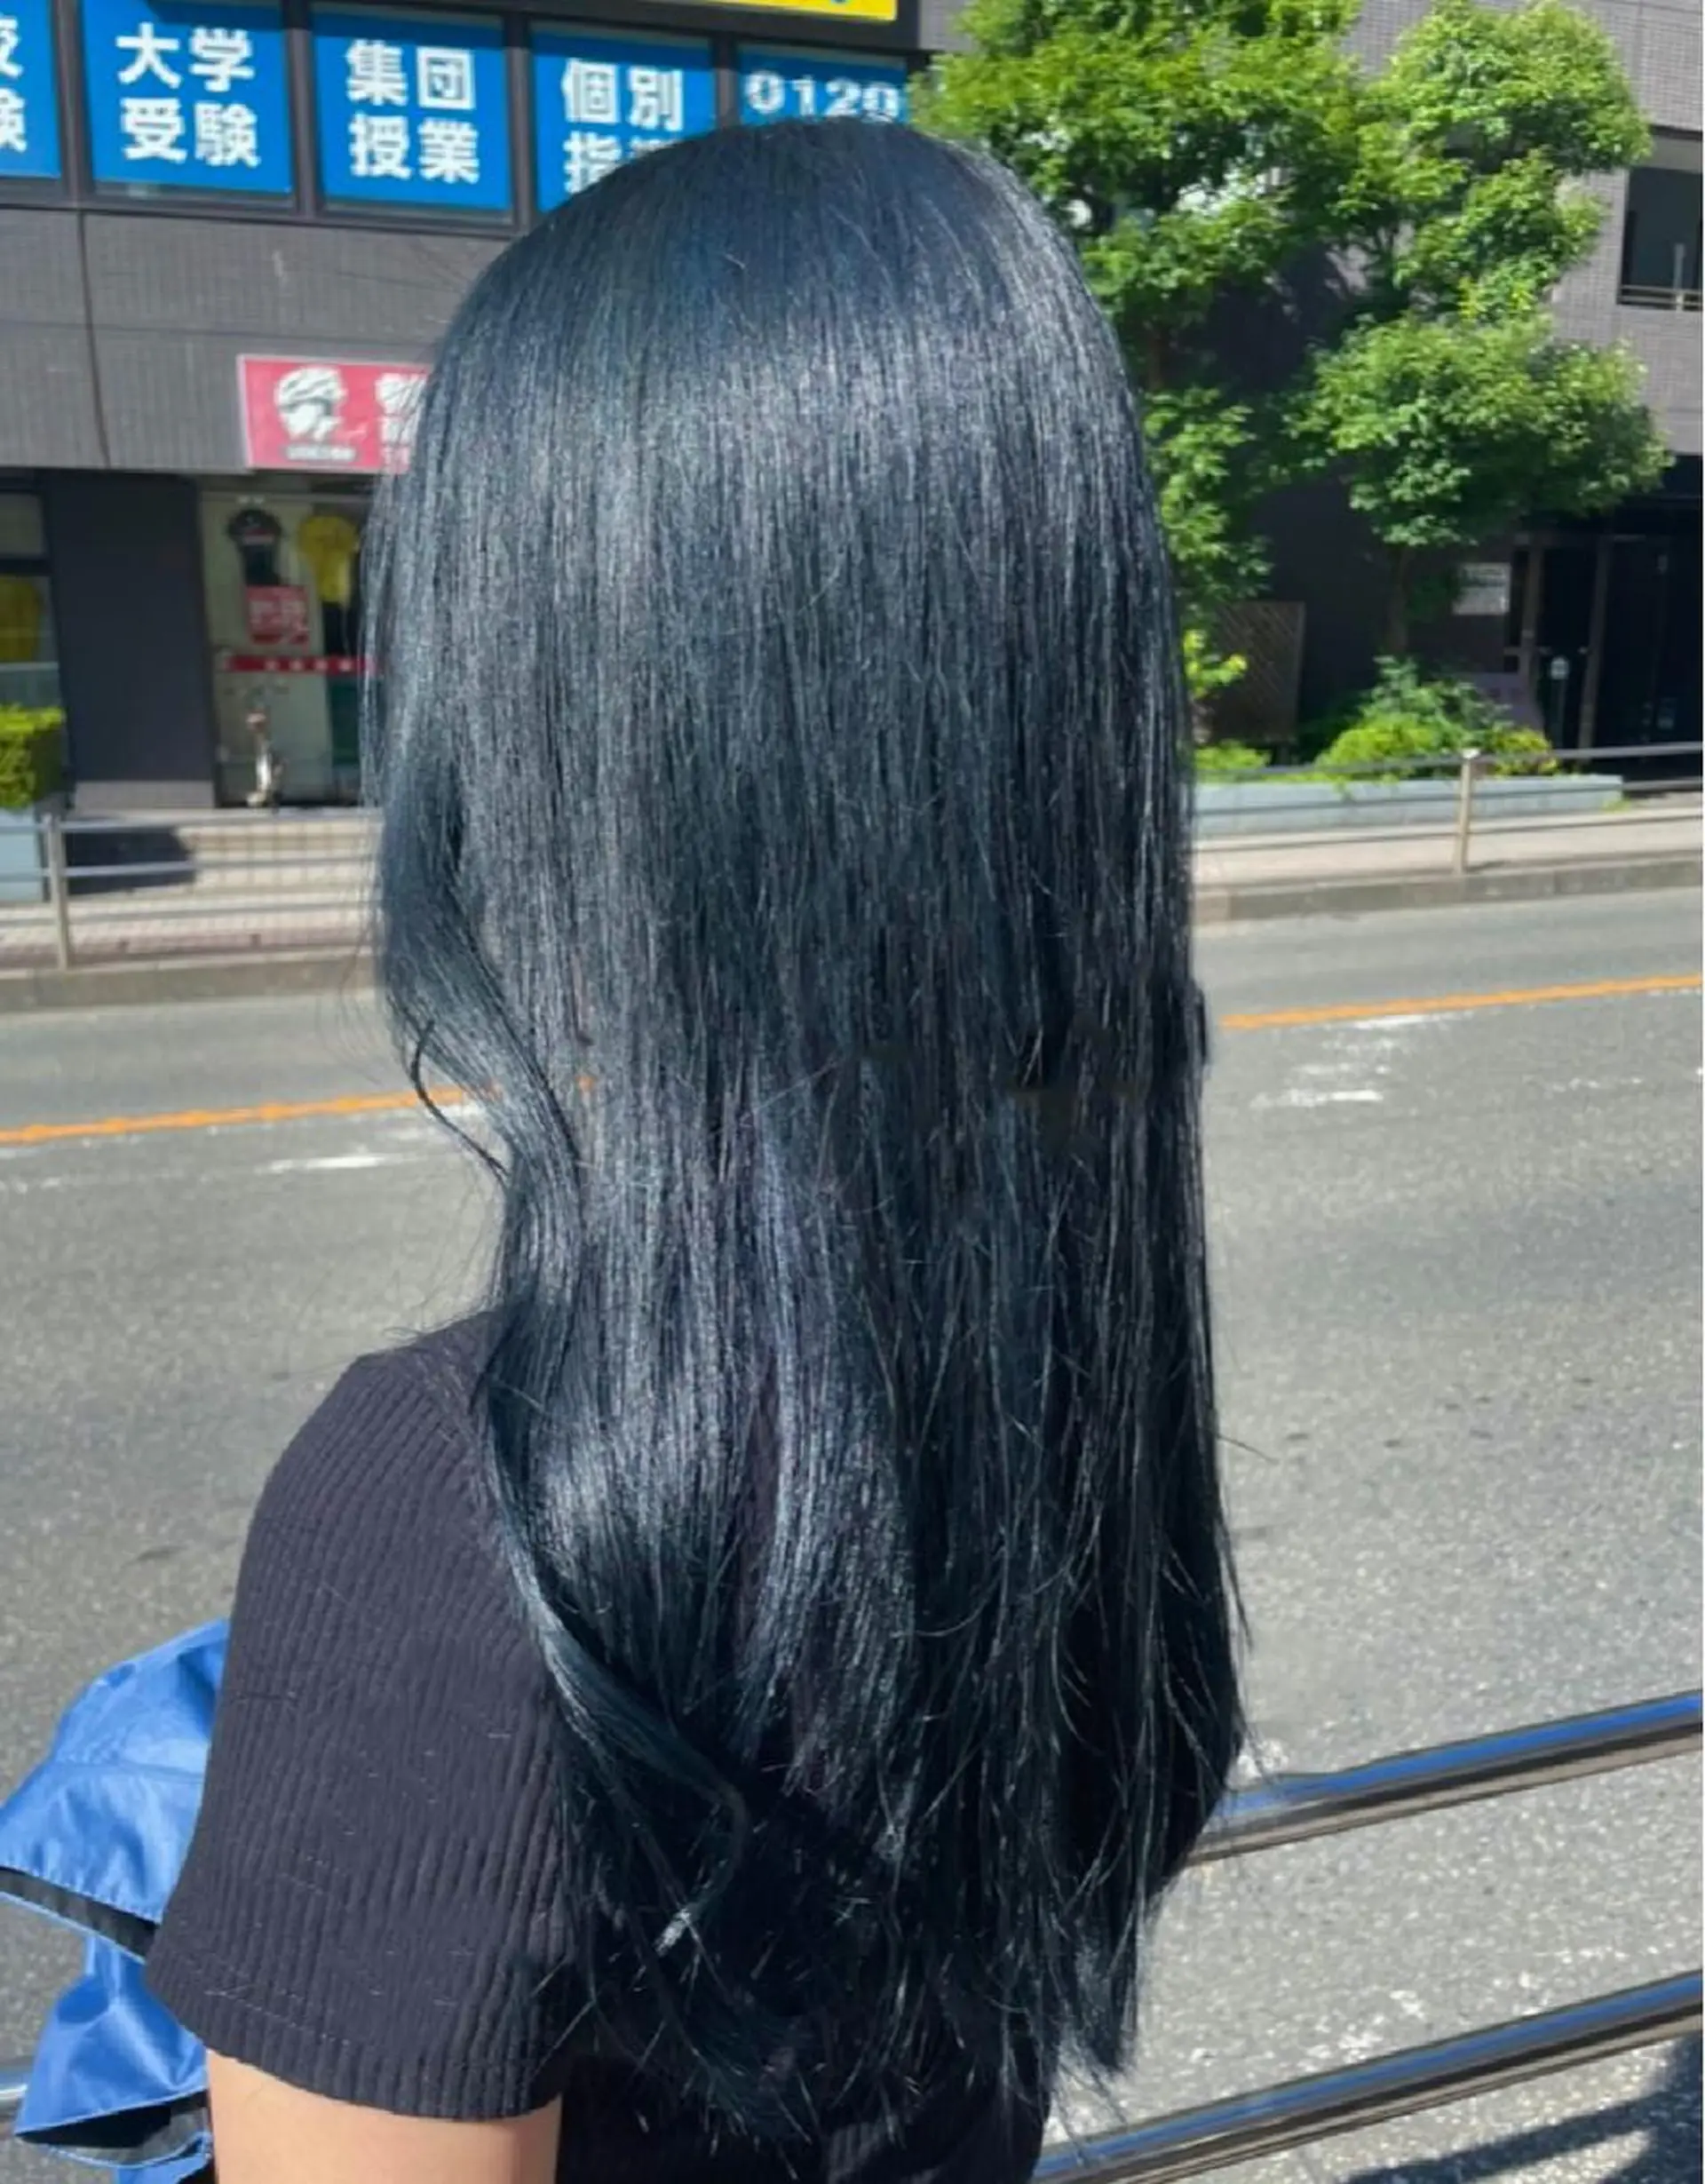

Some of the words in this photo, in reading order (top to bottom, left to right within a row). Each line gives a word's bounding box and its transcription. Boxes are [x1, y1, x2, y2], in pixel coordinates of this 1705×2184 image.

[116, 21, 255, 91] 大学
[346, 39, 476, 110] 集団
[561, 58, 683, 131] 個別
[121, 97, 261, 168] 受験
[349, 113, 480, 184] 授業
[563, 131, 673, 193] 指
